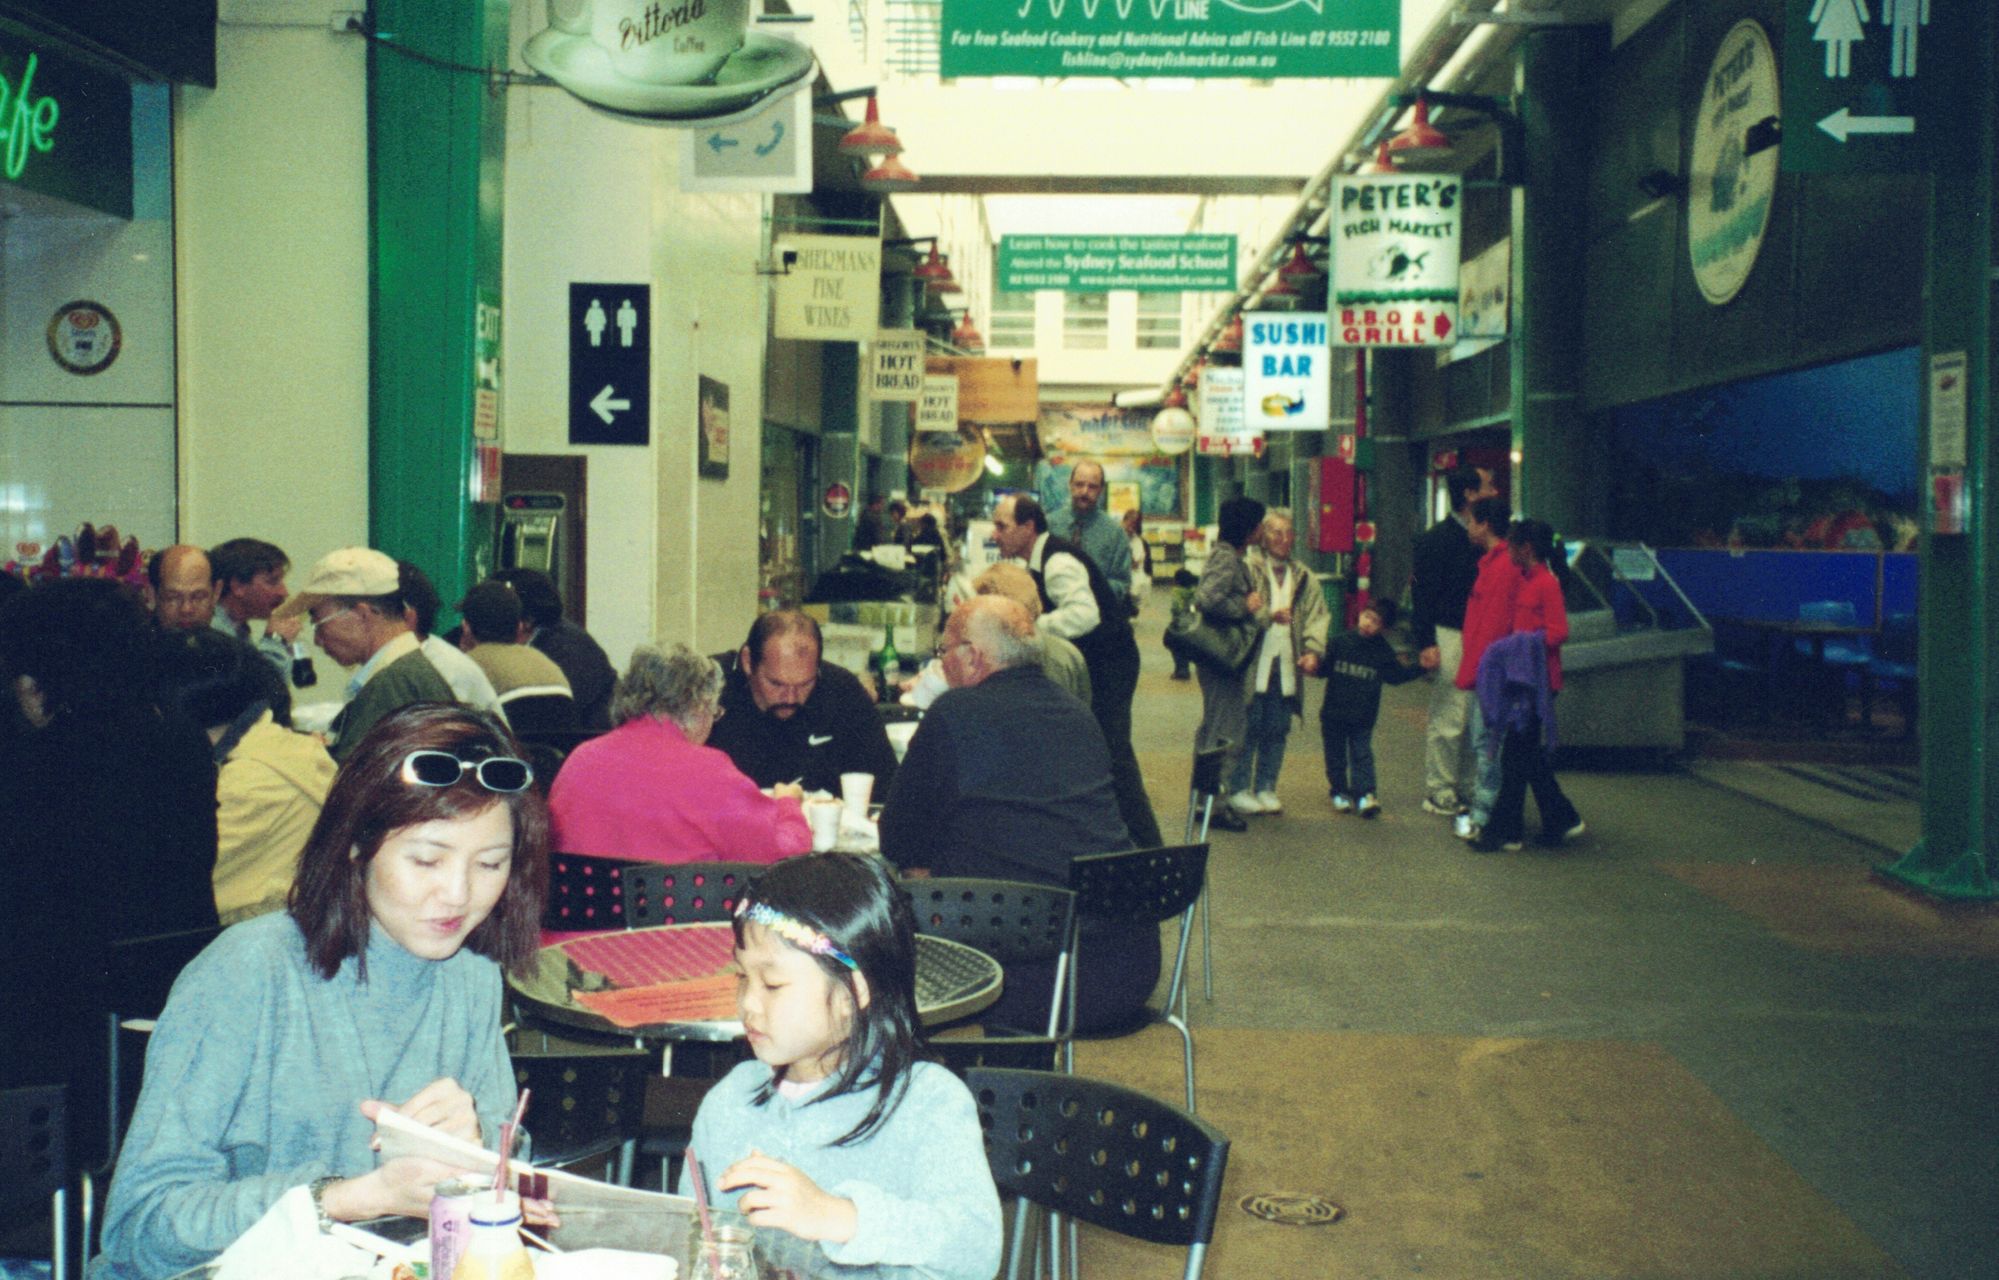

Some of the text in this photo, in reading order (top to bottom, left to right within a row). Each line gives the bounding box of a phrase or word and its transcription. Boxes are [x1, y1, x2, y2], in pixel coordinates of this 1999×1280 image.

[1174, 0, 1209, 20] LINE
[951, 30, 1390, 49] For free Seafood Cookery and Nutritional Advice call Fish Line 02 9552 2180
[1061, 51, 1277, 70] fishline@sydneyfishmarket.com.au
[1341, 180, 1457, 211] PETER'S
[1344, 219, 1453, 238] FISH MARKET
[1008, 238, 1042, 251] Learn
[1044, 238, 1070, 251] how
[1073, 238, 1086, 250] to
[1118, 238, 1138, 251] the
[1063, 254, 1116, 273] Sydney
[1118, 254, 1177, 270] Seafood
[1179, 254, 1229, 270] School
[804, 305, 851, 328] WINES
[1252, 322, 1326, 345] SUSHI
[1342, 327, 1425, 344] GRILL
[879, 354, 917, 370] HOT
[1261, 354, 1313, 377] BAR
[875, 374, 920, 389] BREAD
